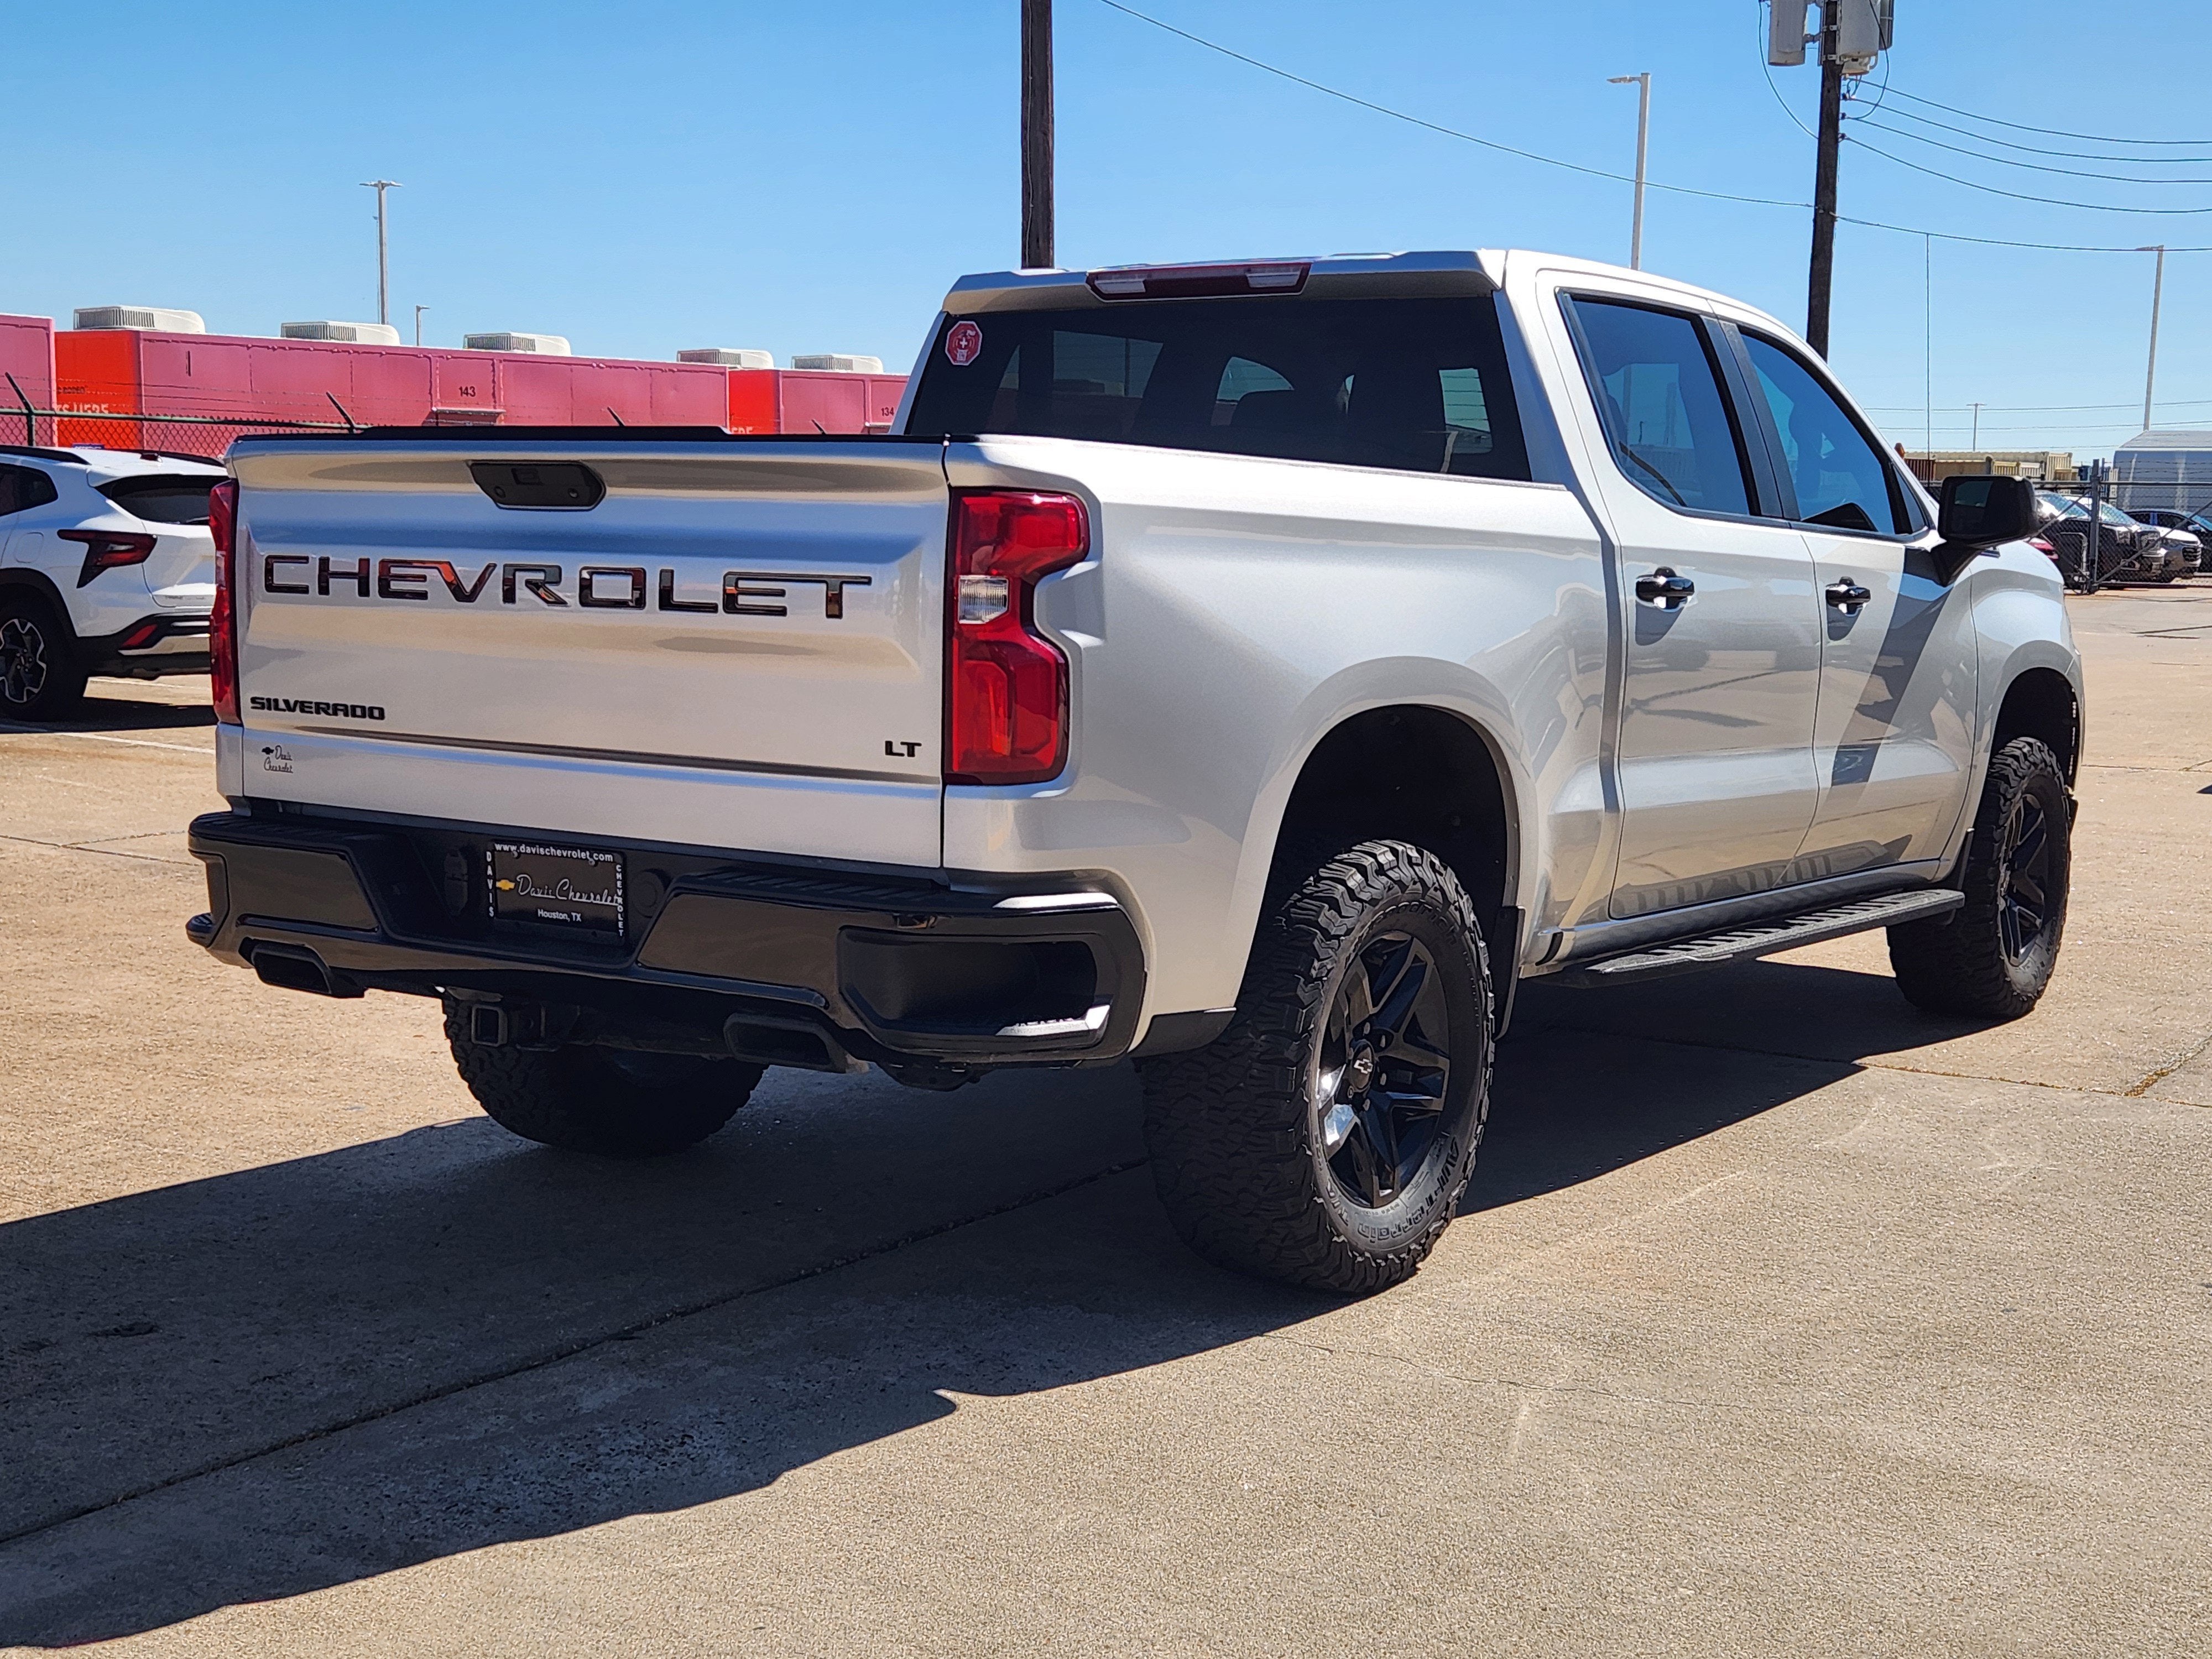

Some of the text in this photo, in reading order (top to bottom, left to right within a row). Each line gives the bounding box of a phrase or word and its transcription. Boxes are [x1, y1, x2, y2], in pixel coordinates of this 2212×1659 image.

[458, 385, 476, 397] 143
[881, 406, 894, 416] 134
[264, 555, 872, 619] CHEVROLET
[250, 696, 385, 721] SILVERADO
[885, 740, 922, 758] LT
[494, 843, 613, 862] www.davischevrolet.com
[486, 851, 494, 917] DAVIS
[516, 874, 619, 906] Davis Chevrolet
[615, 864, 624, 937] CHEVROLET
[537, 909, 582, 922] Houston, TX
